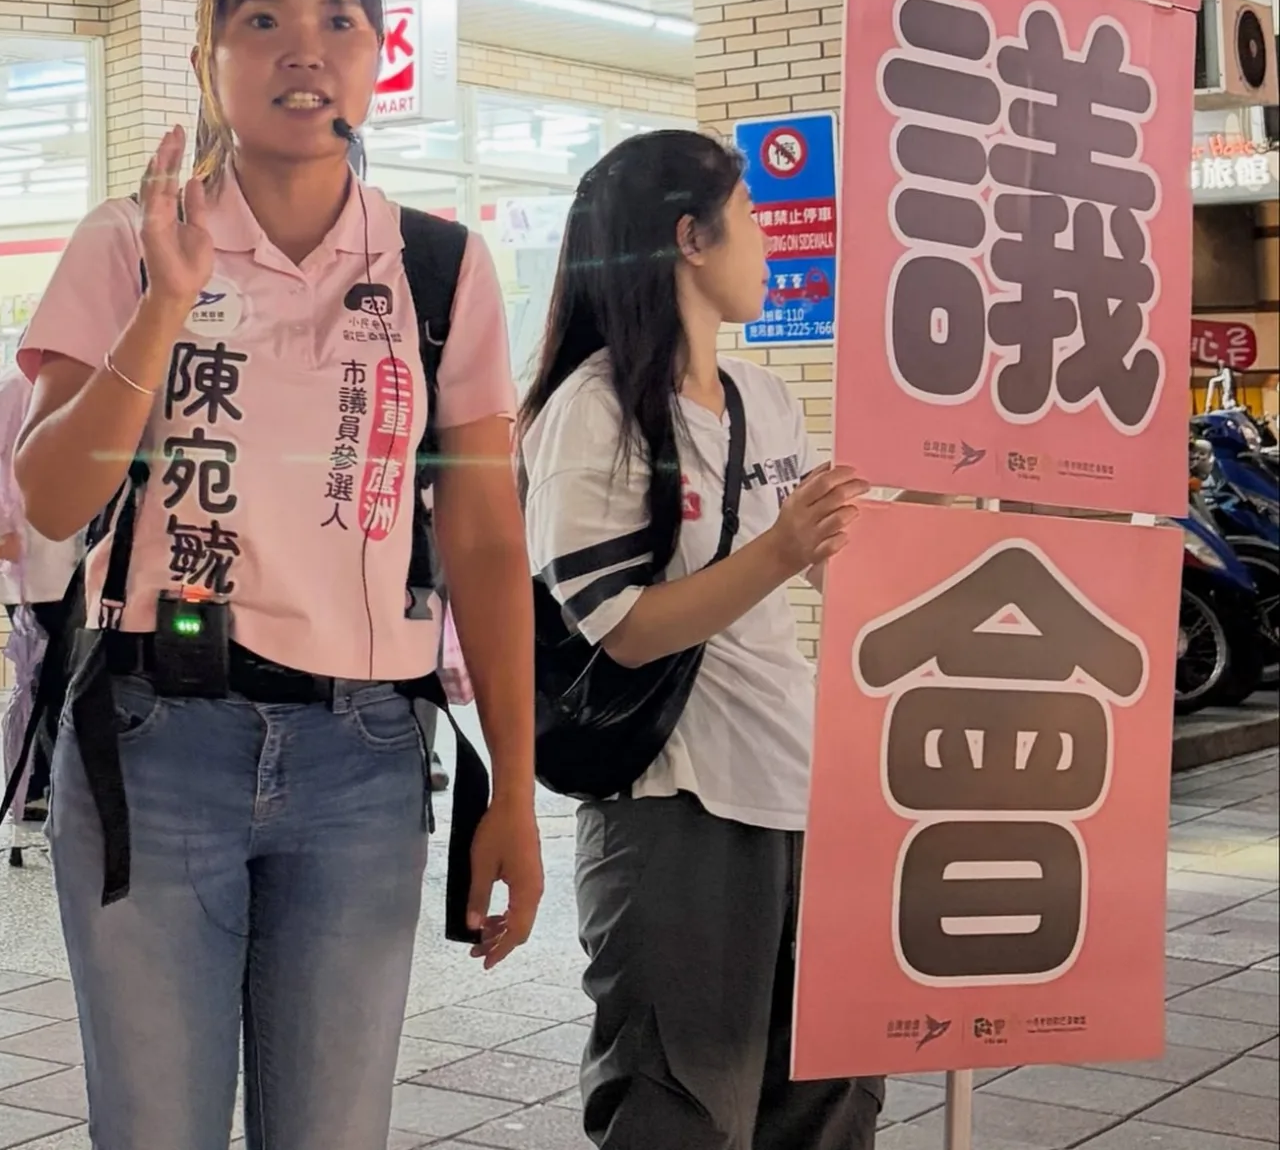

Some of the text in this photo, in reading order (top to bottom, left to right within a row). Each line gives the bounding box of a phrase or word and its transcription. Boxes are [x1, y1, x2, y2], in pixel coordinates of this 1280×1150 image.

[376, 97, 415, 114] MART
[750, 206, 832, 227] 樓禁止停車
[164, 342, 248, 594] 陳宛毓
[320, 358, 369, 531] 市議員參選人
[363, 363, 412, 534] 三重 蘆洲
